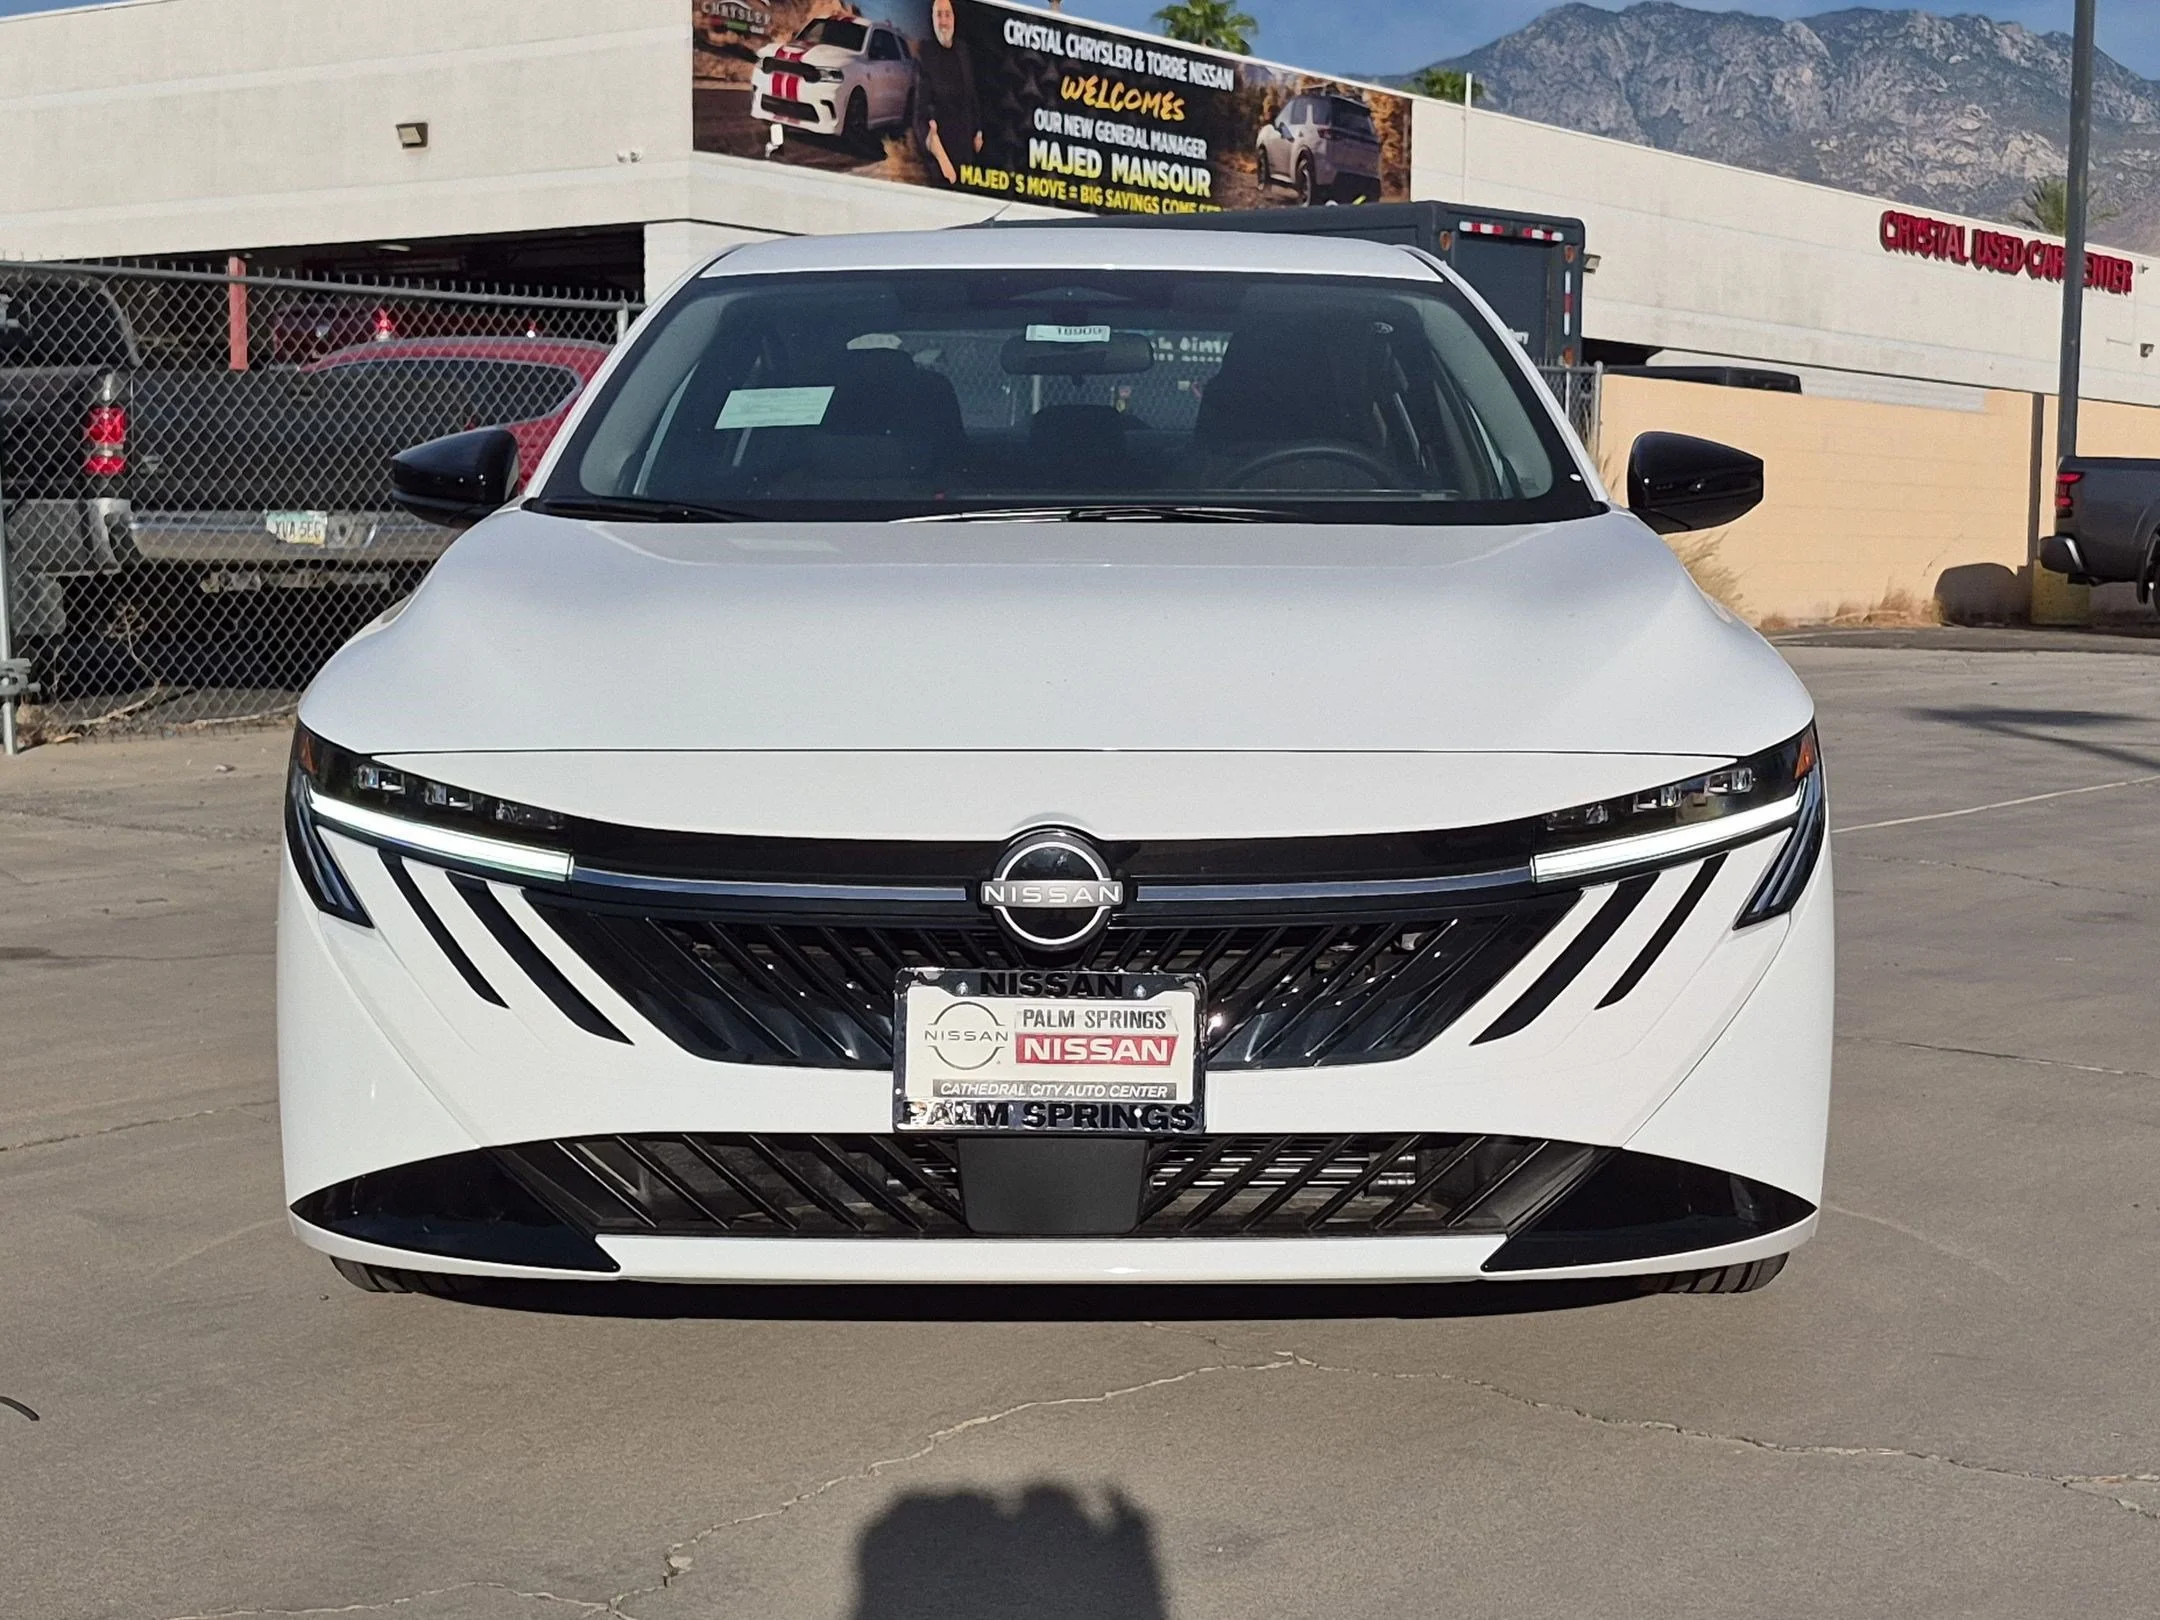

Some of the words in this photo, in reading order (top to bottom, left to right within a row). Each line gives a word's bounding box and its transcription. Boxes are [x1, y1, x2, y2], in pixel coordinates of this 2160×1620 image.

[1003, 18, 1065, 56] CRYSTAL
[1065, 34, 1133, 71] CHRYSLER
[1133, 48, 1145, 73] &
[1145, 50, 1187, 82] TORRE
[1188, 60, 1234, 92] NISSAN
[1060, 75, 1185, 121] WELCOMES
[1033, 107, 1063, 134] OUR
[1064, 114, 1094, 140] NEW
[1095, 120, 1150, 150] GENERAL
[1150, 130, 1207, 160] MANAGER
[1029, 138, 1103, 179] MAJED
[1111, 153, 1211, 197] MANSOUR
[1027, 175, 1067, 200] MOVE
[1080, 184, 1103, 206] BIG
[1105, 189, 1160, 215] SAVINGS
[1879, 209, 1970, 266] CRYSTAL
[1971, 228, 2024, 276] USED
[2082, 251, 2133, 296] ENTER
[984, 885, 1120, 903] NISSAN
[980, 971, 1123, 998] NISSAN
[1023, 1008, 1075, 1028] PALM
[1084, 1009, 1167, 1030] SPRINGS
[924, 1030, 1008, 1042] NISSAN
[1024, 1037, 1168, 1062] NISSAN
[940, 1082, 1026, 1096] CATHEDRAL
[1030, 1083, 1062, 1097] CITY
[1065, 1084, 1106, 1098] AUTO
[1109, 1085, 1168, 1098] CENTER
[903, 1101, 1009, 1126] PALM
[1022, 1101, 1195, 1131] SPRINGS
